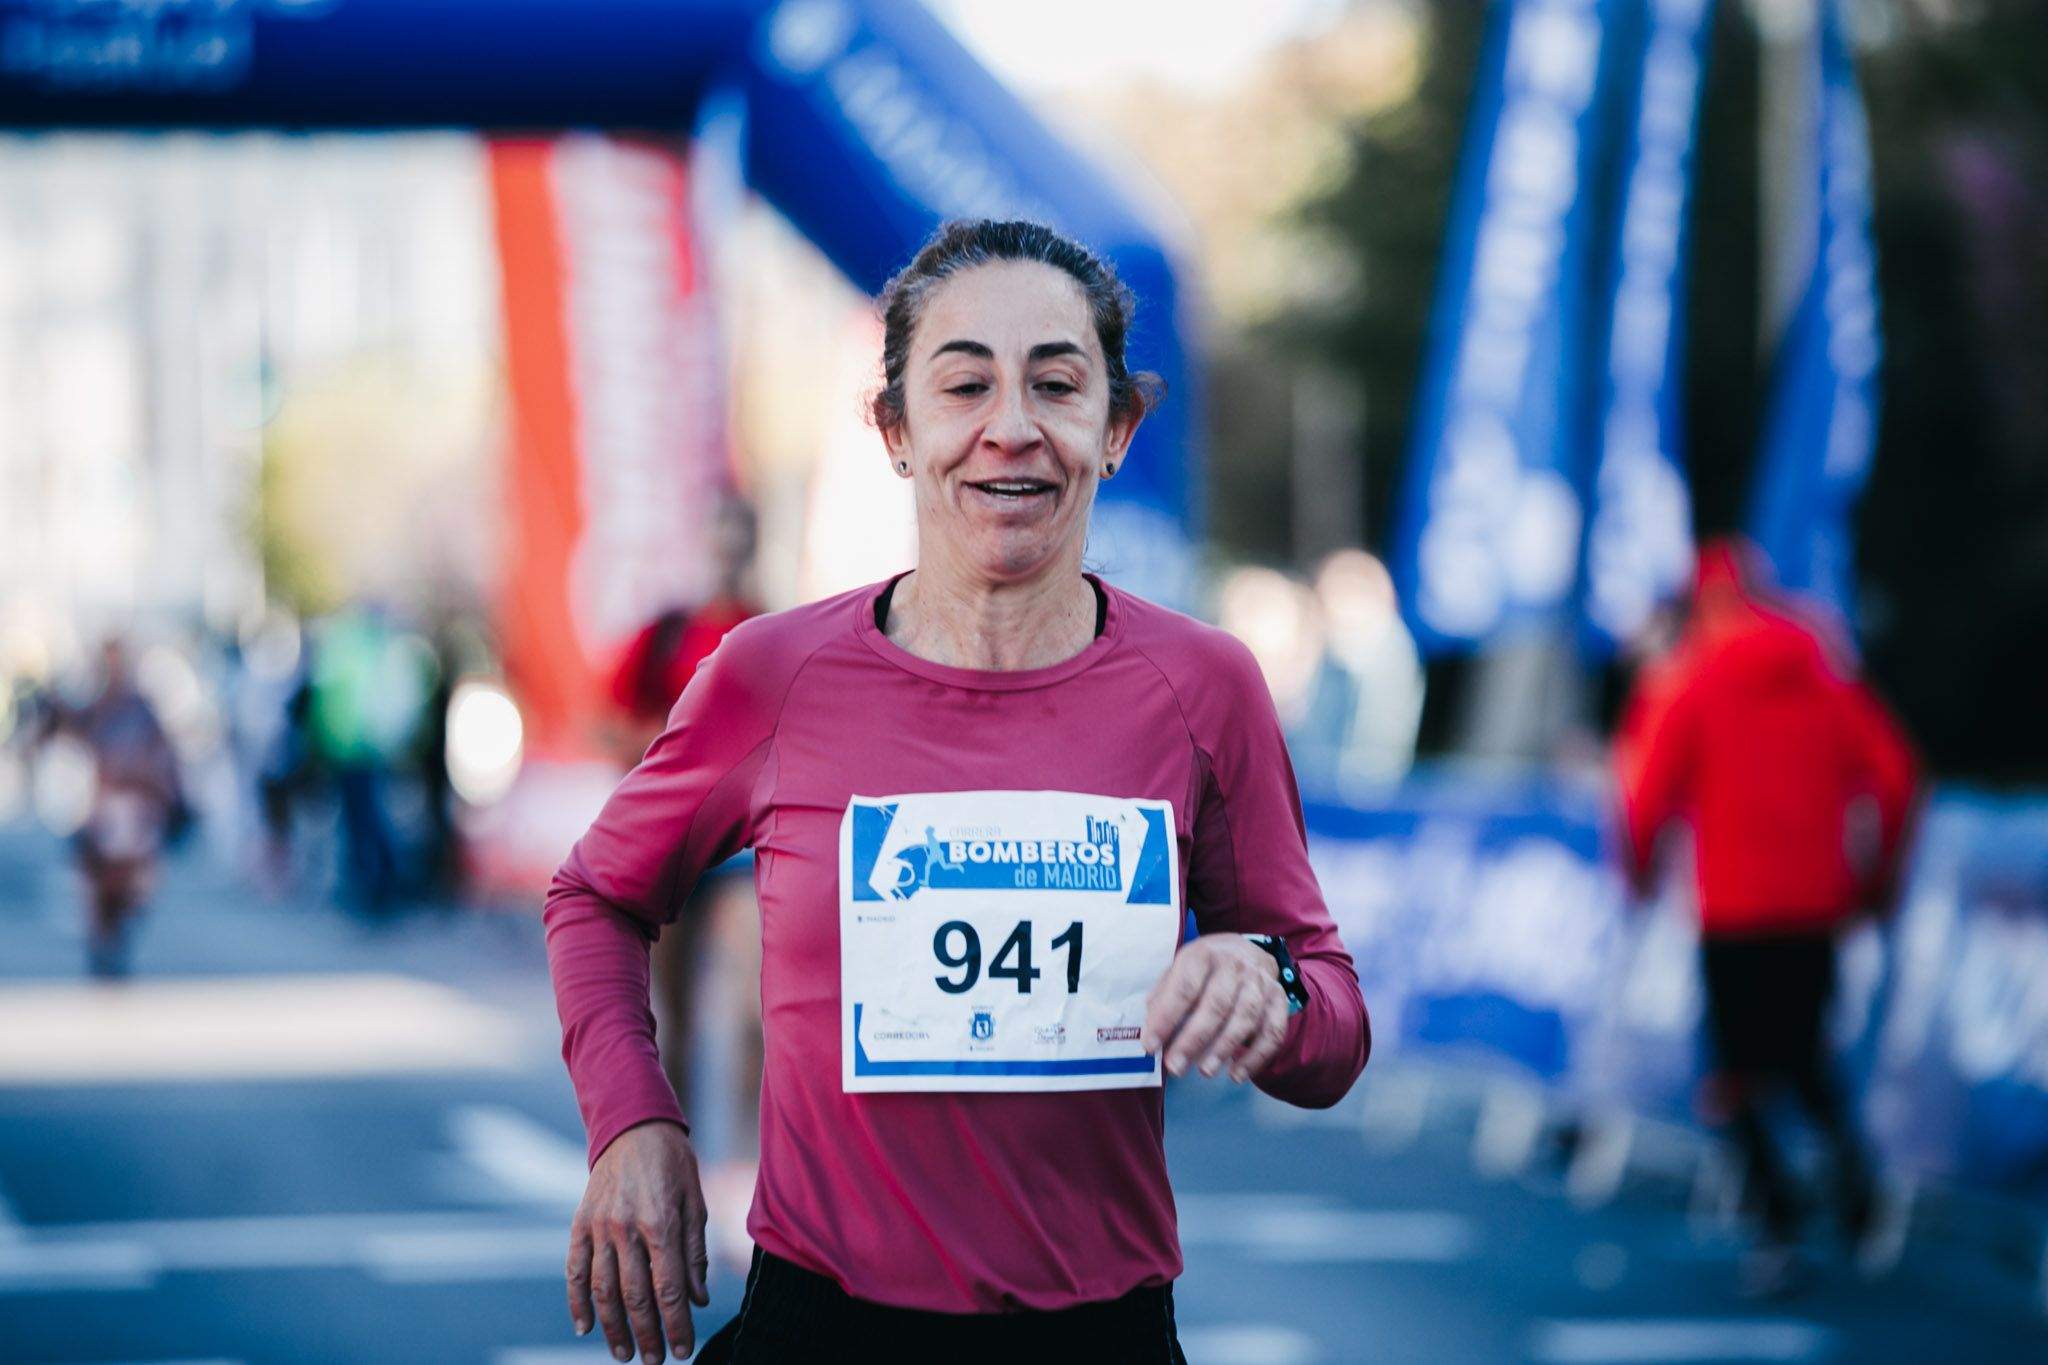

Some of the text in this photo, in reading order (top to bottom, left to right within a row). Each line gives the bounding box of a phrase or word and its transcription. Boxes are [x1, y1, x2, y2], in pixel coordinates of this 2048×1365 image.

[949, 841, 1116, 867] BOMBEROS
[1014, 863, 1117, 890] de MADRID
[933, 920, 1084, 994] 941
